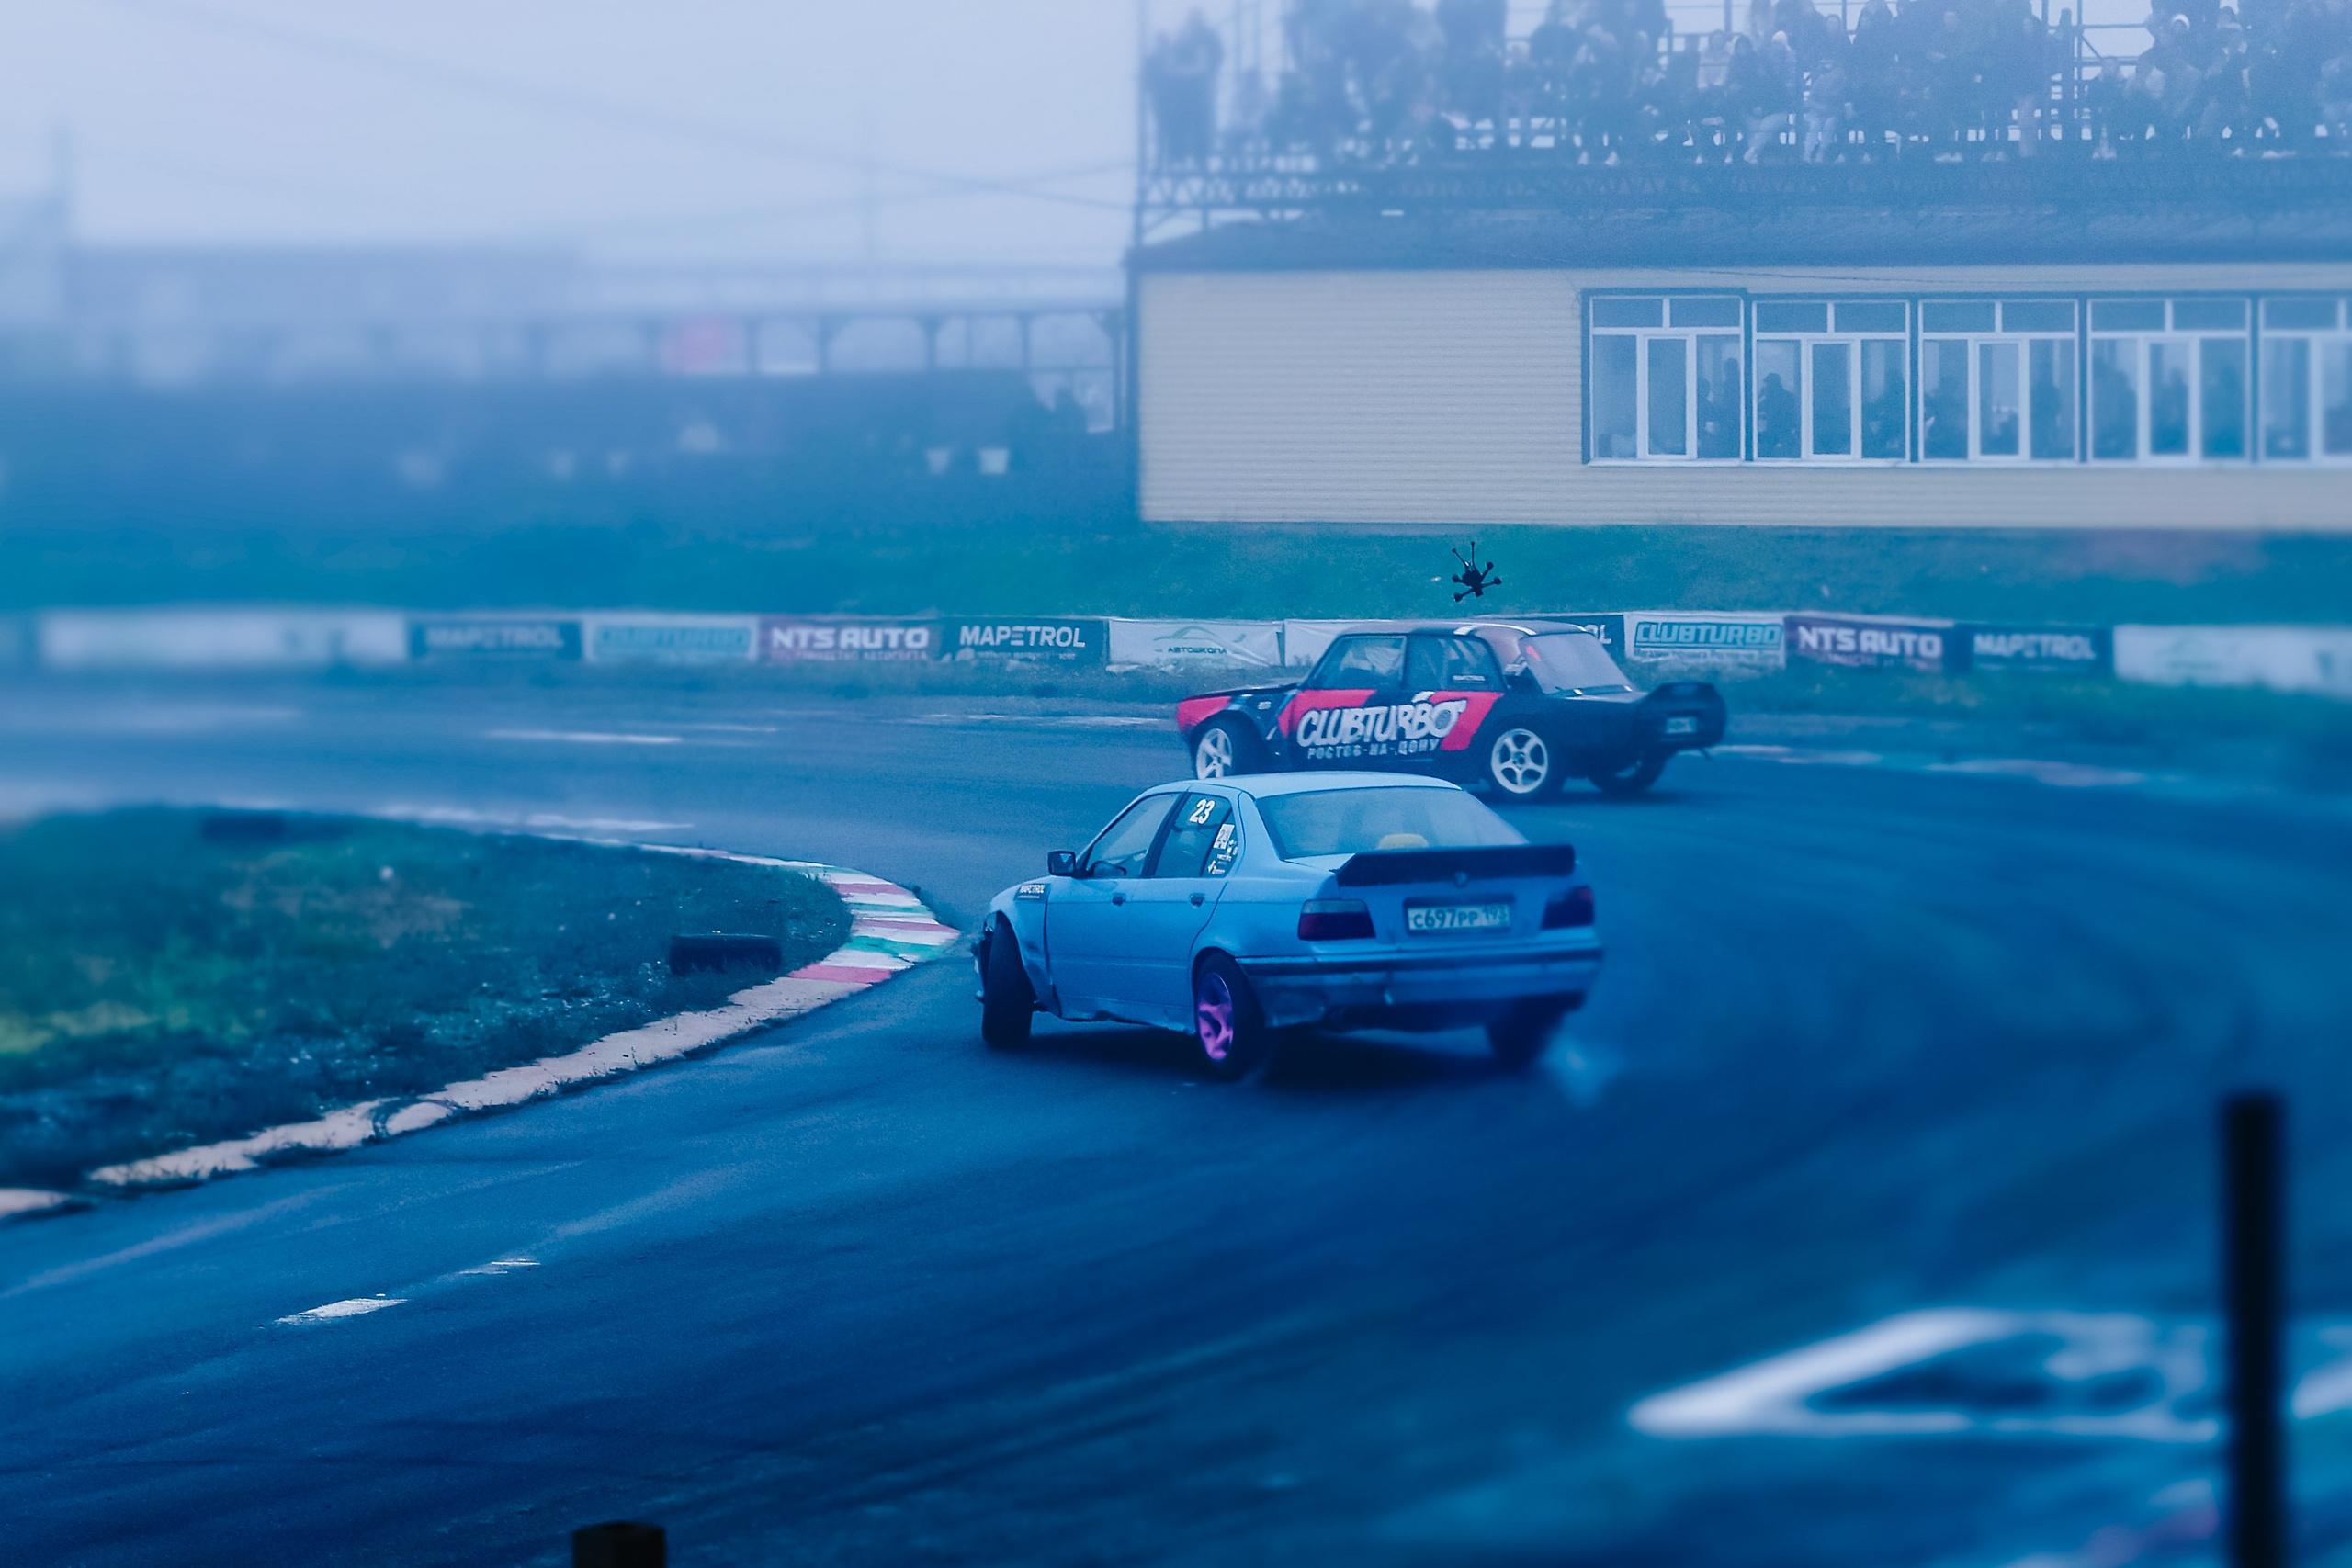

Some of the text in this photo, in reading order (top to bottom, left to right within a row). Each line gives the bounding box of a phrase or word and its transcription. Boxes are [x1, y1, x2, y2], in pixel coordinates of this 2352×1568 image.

[772, 627, 930, 649] NTS AUTO
[959, 626, 1086, 648] MAPETROL
[1635, 622, 1782, 646] CLUBTURBO
[1797, 626, 1943, 659] NTS AUTO
[1296, 699, 1468, 747] CLUBTURBO
[1189, 799, 1216, 824] 23
